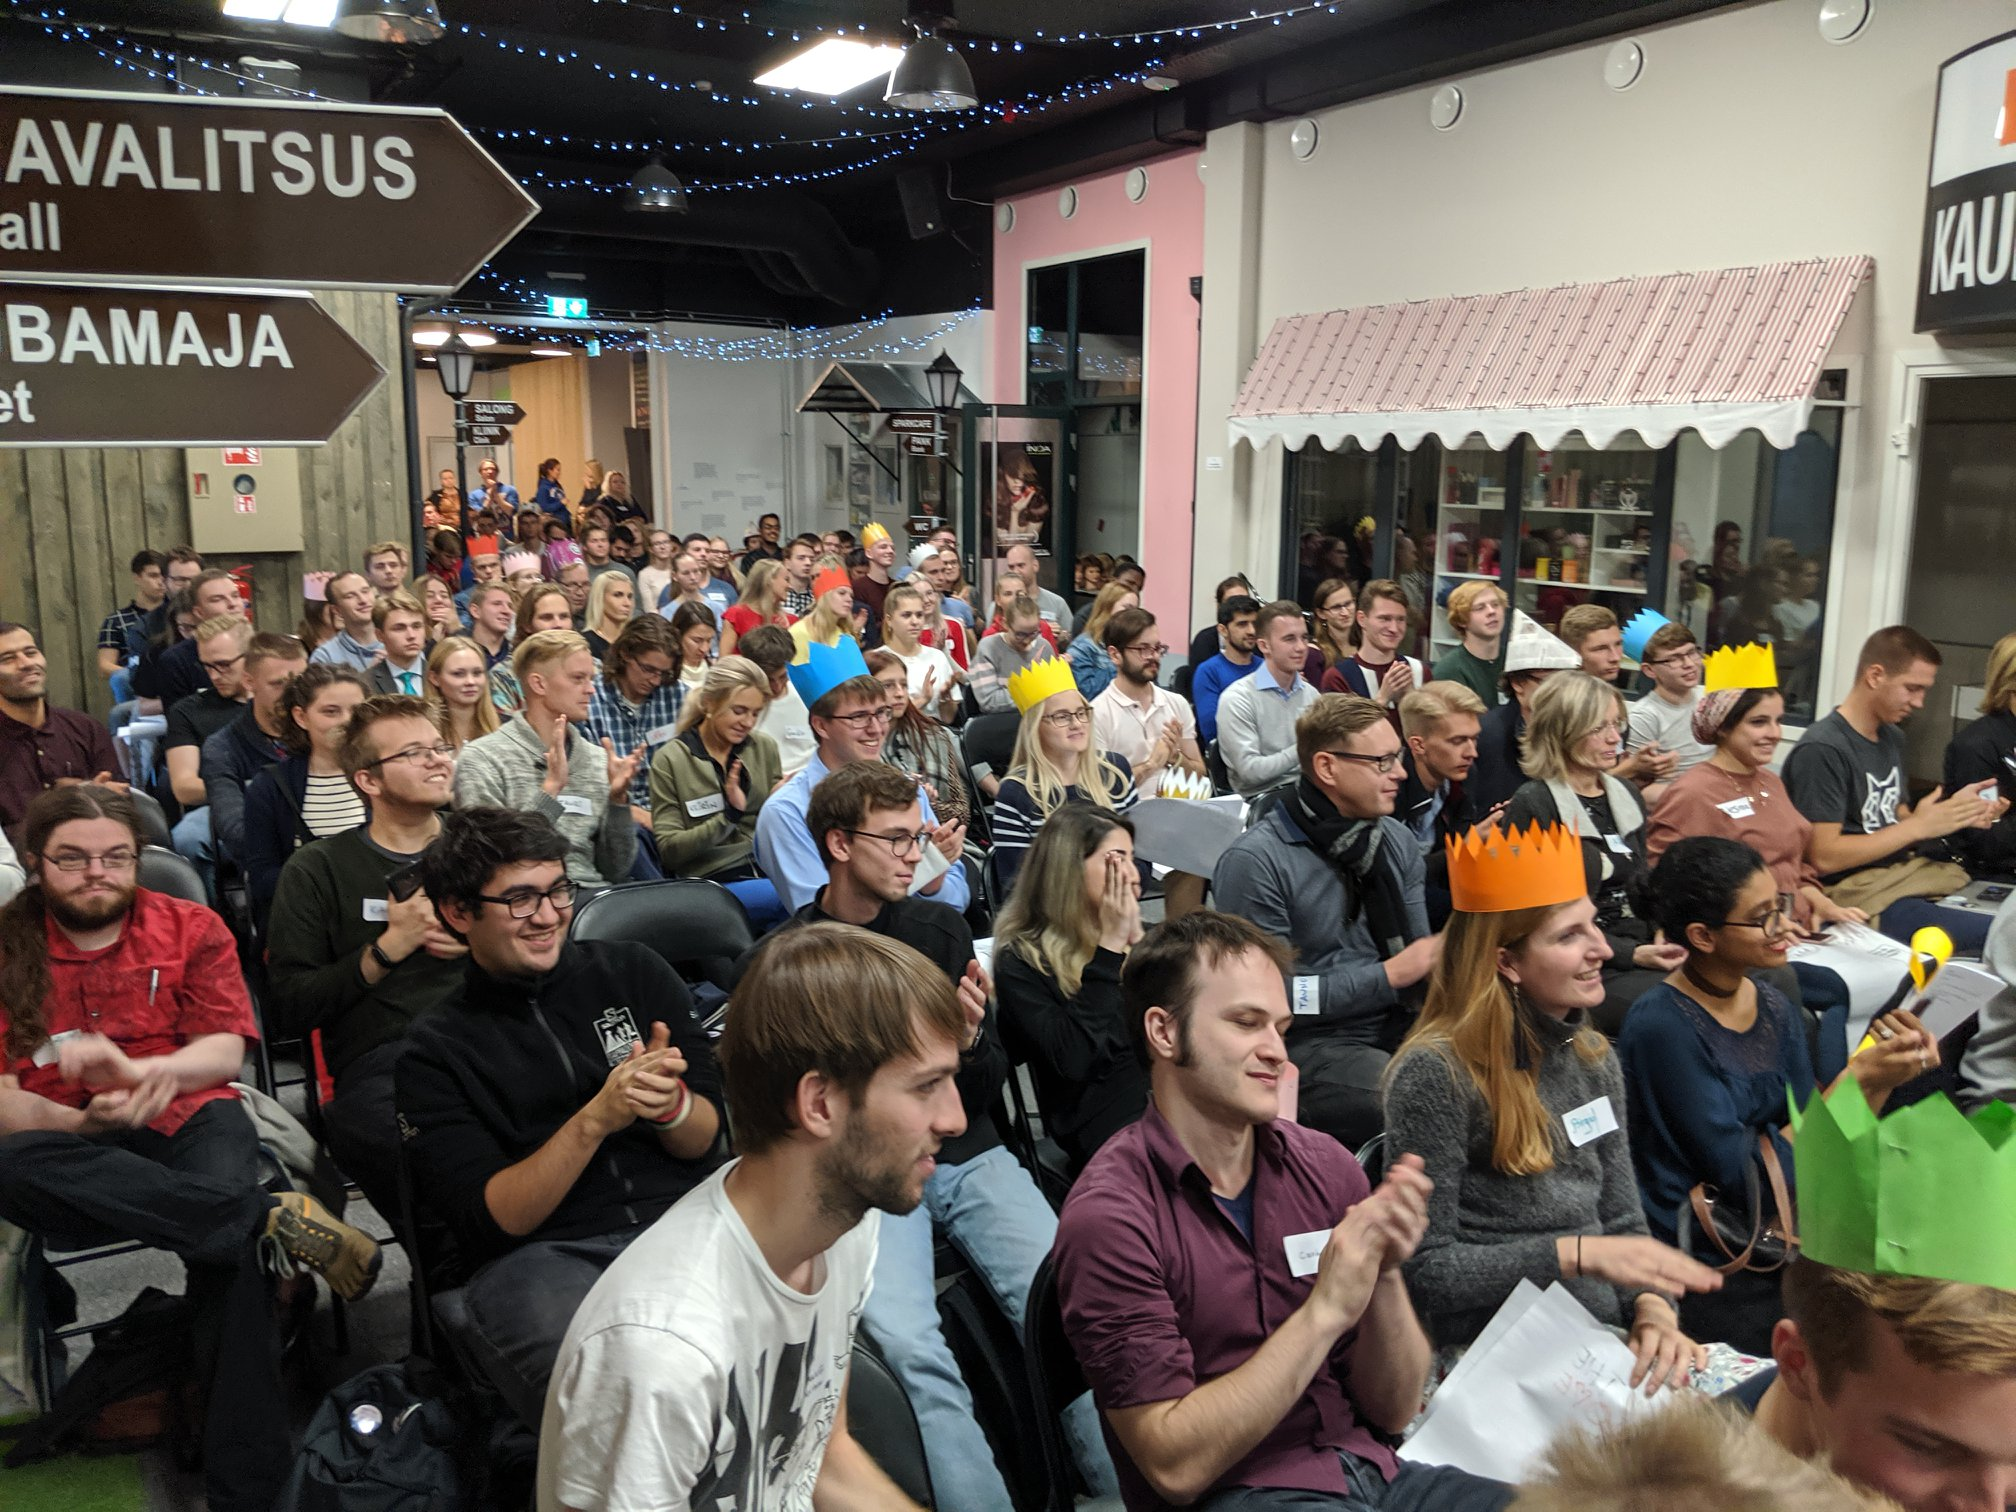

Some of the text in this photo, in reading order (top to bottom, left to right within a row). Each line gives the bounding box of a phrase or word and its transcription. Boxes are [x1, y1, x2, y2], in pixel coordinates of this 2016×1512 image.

[5, 118, 417, 200] AVALITSUS
[1929, 190, 2016, 295] KAU
[5, 303, 294, 369] BAMAJA
[475, 403, 515, 414] SALONG
[914, 523, 929, 531] WC
